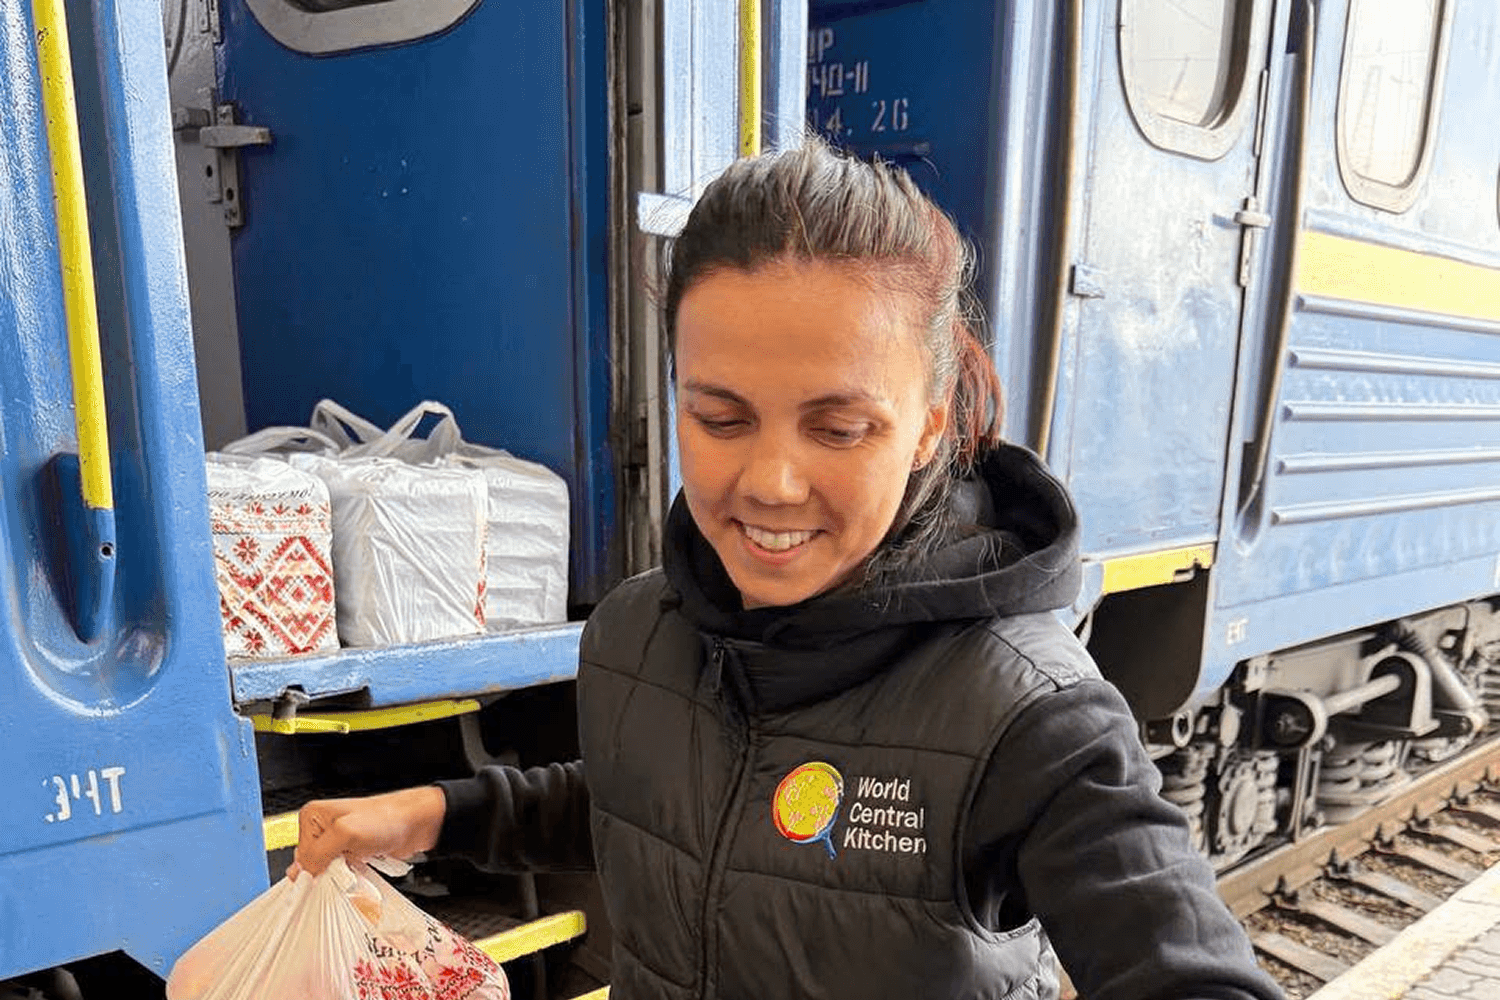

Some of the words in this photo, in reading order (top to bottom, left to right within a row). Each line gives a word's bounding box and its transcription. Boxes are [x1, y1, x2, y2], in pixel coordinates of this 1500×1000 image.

[856, 776, 911, 802] World
[849, 802, 925, 829] Central
[843, 827, 927, 854] Kitchen
